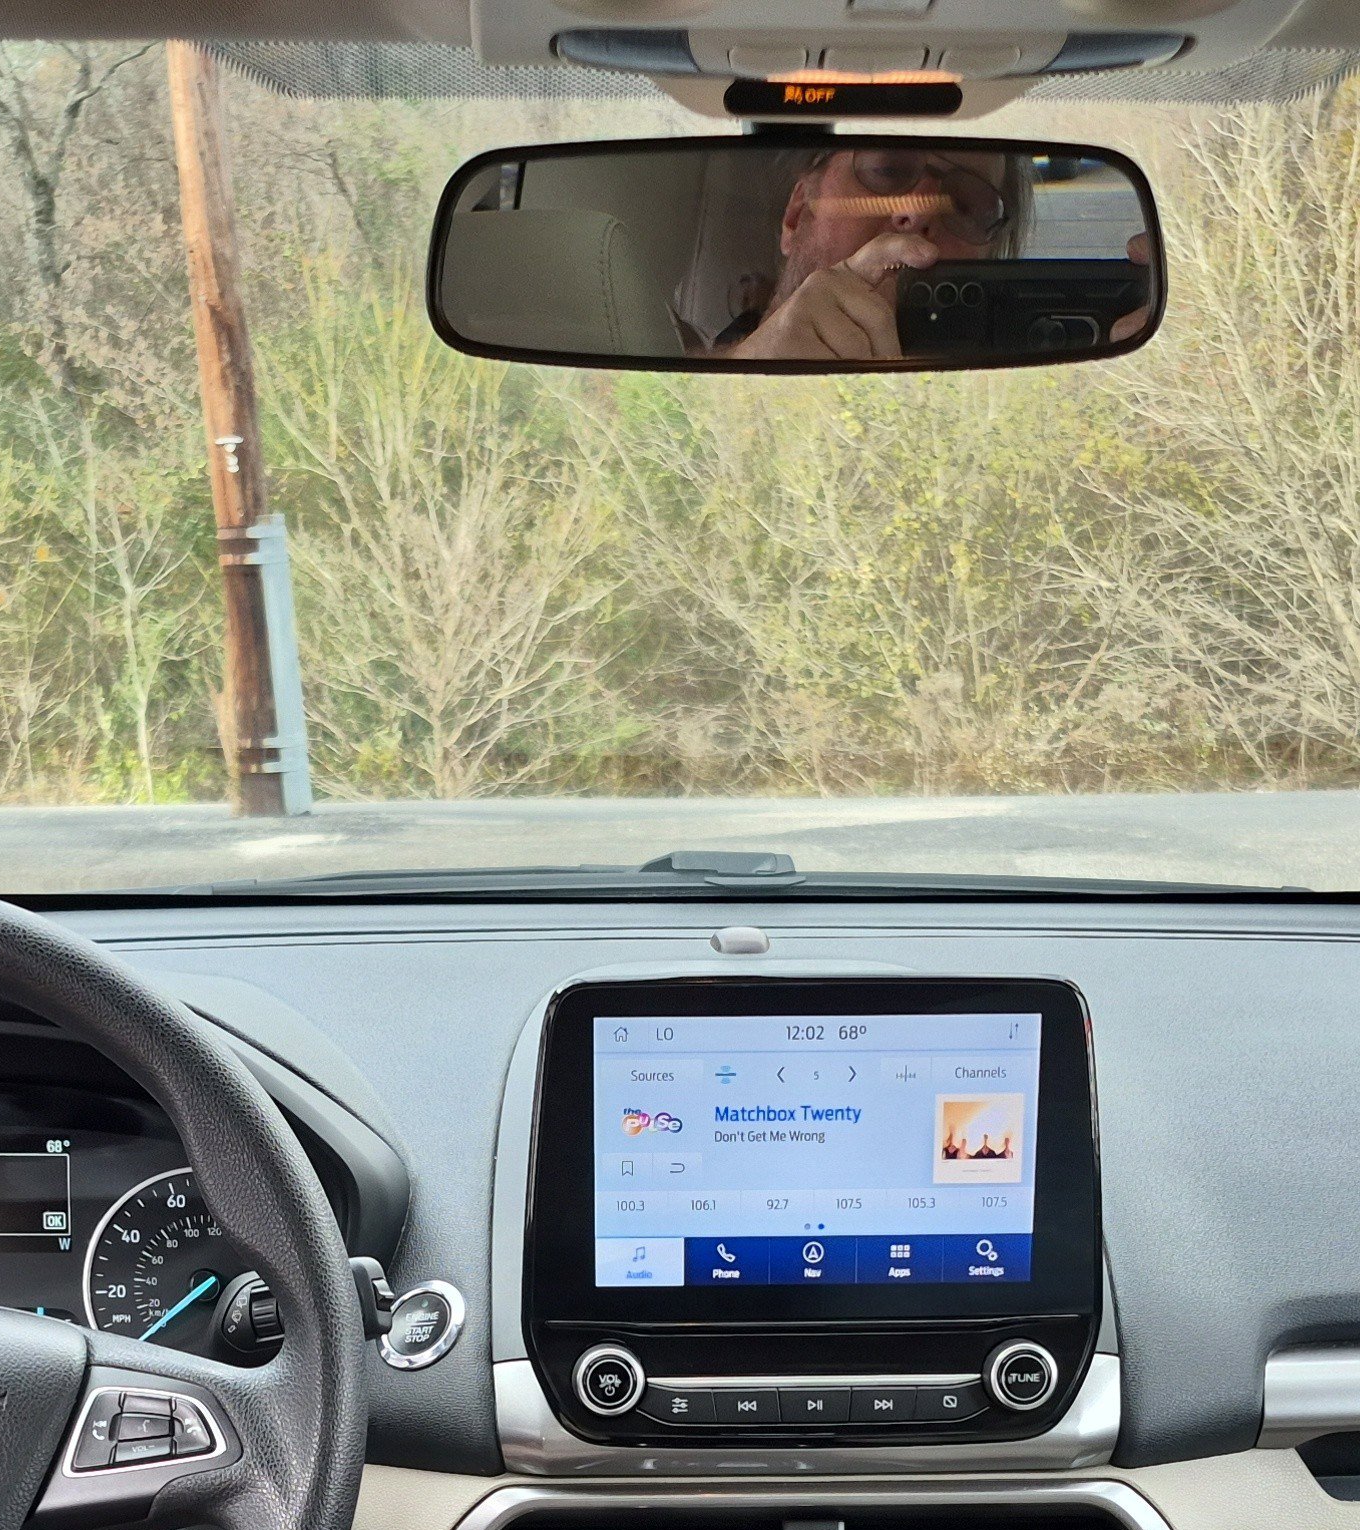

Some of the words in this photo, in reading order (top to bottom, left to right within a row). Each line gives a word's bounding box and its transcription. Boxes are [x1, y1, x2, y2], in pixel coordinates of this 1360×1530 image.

[804, 88, 836, 103] OFF
[656, 1027, 674, 1041] LO
[786, 1025, 825, 1041] 12:02
[630, 1070, 675, 1082] Sources
[813, 1071, 820, 1081] 5
[954, 1066, 1007, 1079] Channels
[714, 1105, 796, 1122] Matchbox
[800, 1105, 862, 1124] Twenty
[714, 1131, 745, 1143] Don't
[747, 1131, 766, 1142] Get
[769, 1131, 786, 1142] Me
[789, 1131, 826, 1144] Wrong
[167, 1194, 186, 1208] 60
[616, 1200, 645, 1211] 100.3
[691, 1199, 716, 1211] 106.1
[766, 1198, 789, 1210] 92.7
[908, 1197, 936, 1209] 105.3
[47, 1216, 63, 1227] OK
[121, 1229, 140, 1243] 40
[184, 1229, 199, 1237] 100
[58, 1237, 71, 1250] W
[166, 1239, 179, 1248] 80
[151, 1256, 164, 1265] 60
[712, 1268, 740, 1279] Phone
[804, 1267, 822, 1278] Nav
[888, 1266, 911, 1279] Apps
[968, 1265, 1005, 1277] Settings
[145, 1277, 158, 1286] 40
[108, 1285, 126, 1298] 20
[149, 1299, 160, 1307] 20
[112, 1314, 131, 1323] MPH
[405, 1311, 439, 1321] ENGINE
[405, 1326, 434, 1335] START
[404, 1334, 430, 1343] STOP
[1009, 1373, 1040, 1383] TUNE
